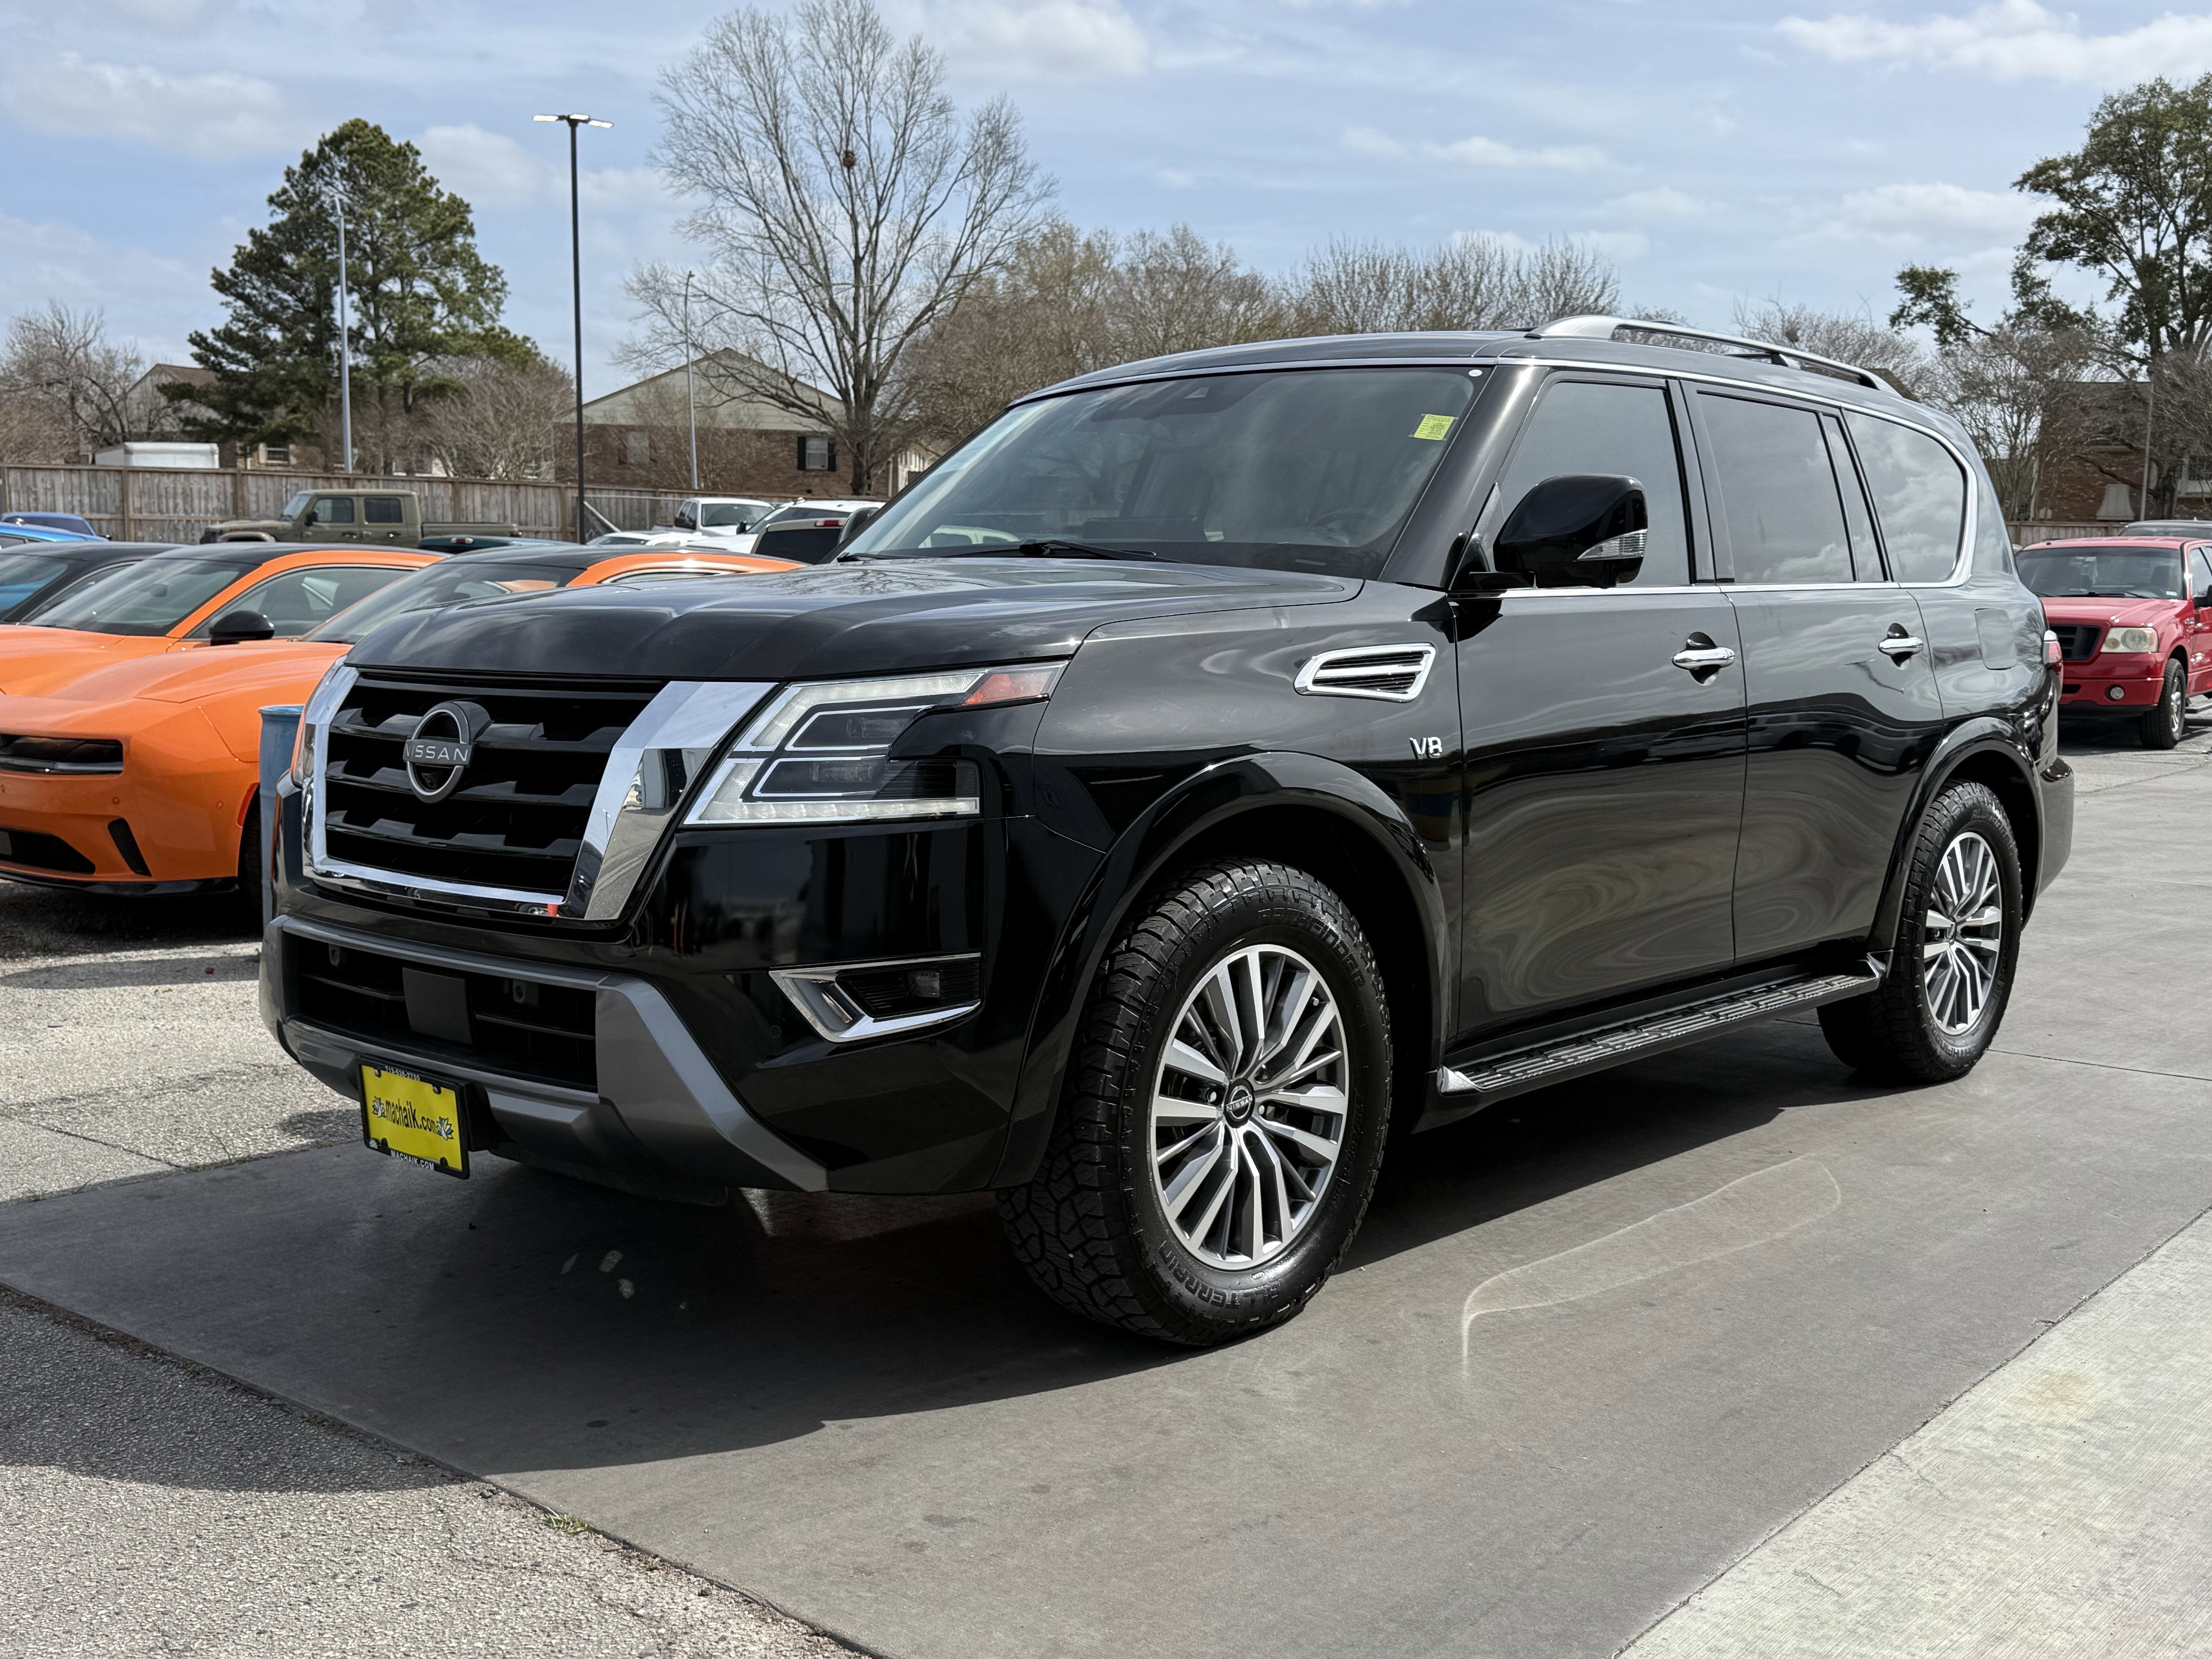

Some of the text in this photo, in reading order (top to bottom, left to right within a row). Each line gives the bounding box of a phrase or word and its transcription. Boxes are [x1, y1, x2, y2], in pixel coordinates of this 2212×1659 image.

[406, 744, 468, 761] NISSAN
[1410, 737, 1443, 759] V8
[1226, 1096, 1253, 1112] NISSAN
[385, 1098, 436, 1134] machaik.com
[391, 1150, 434, 1170] MACHAIK.COM
[1159, 1240, 1240, 1309] TERRAIN
